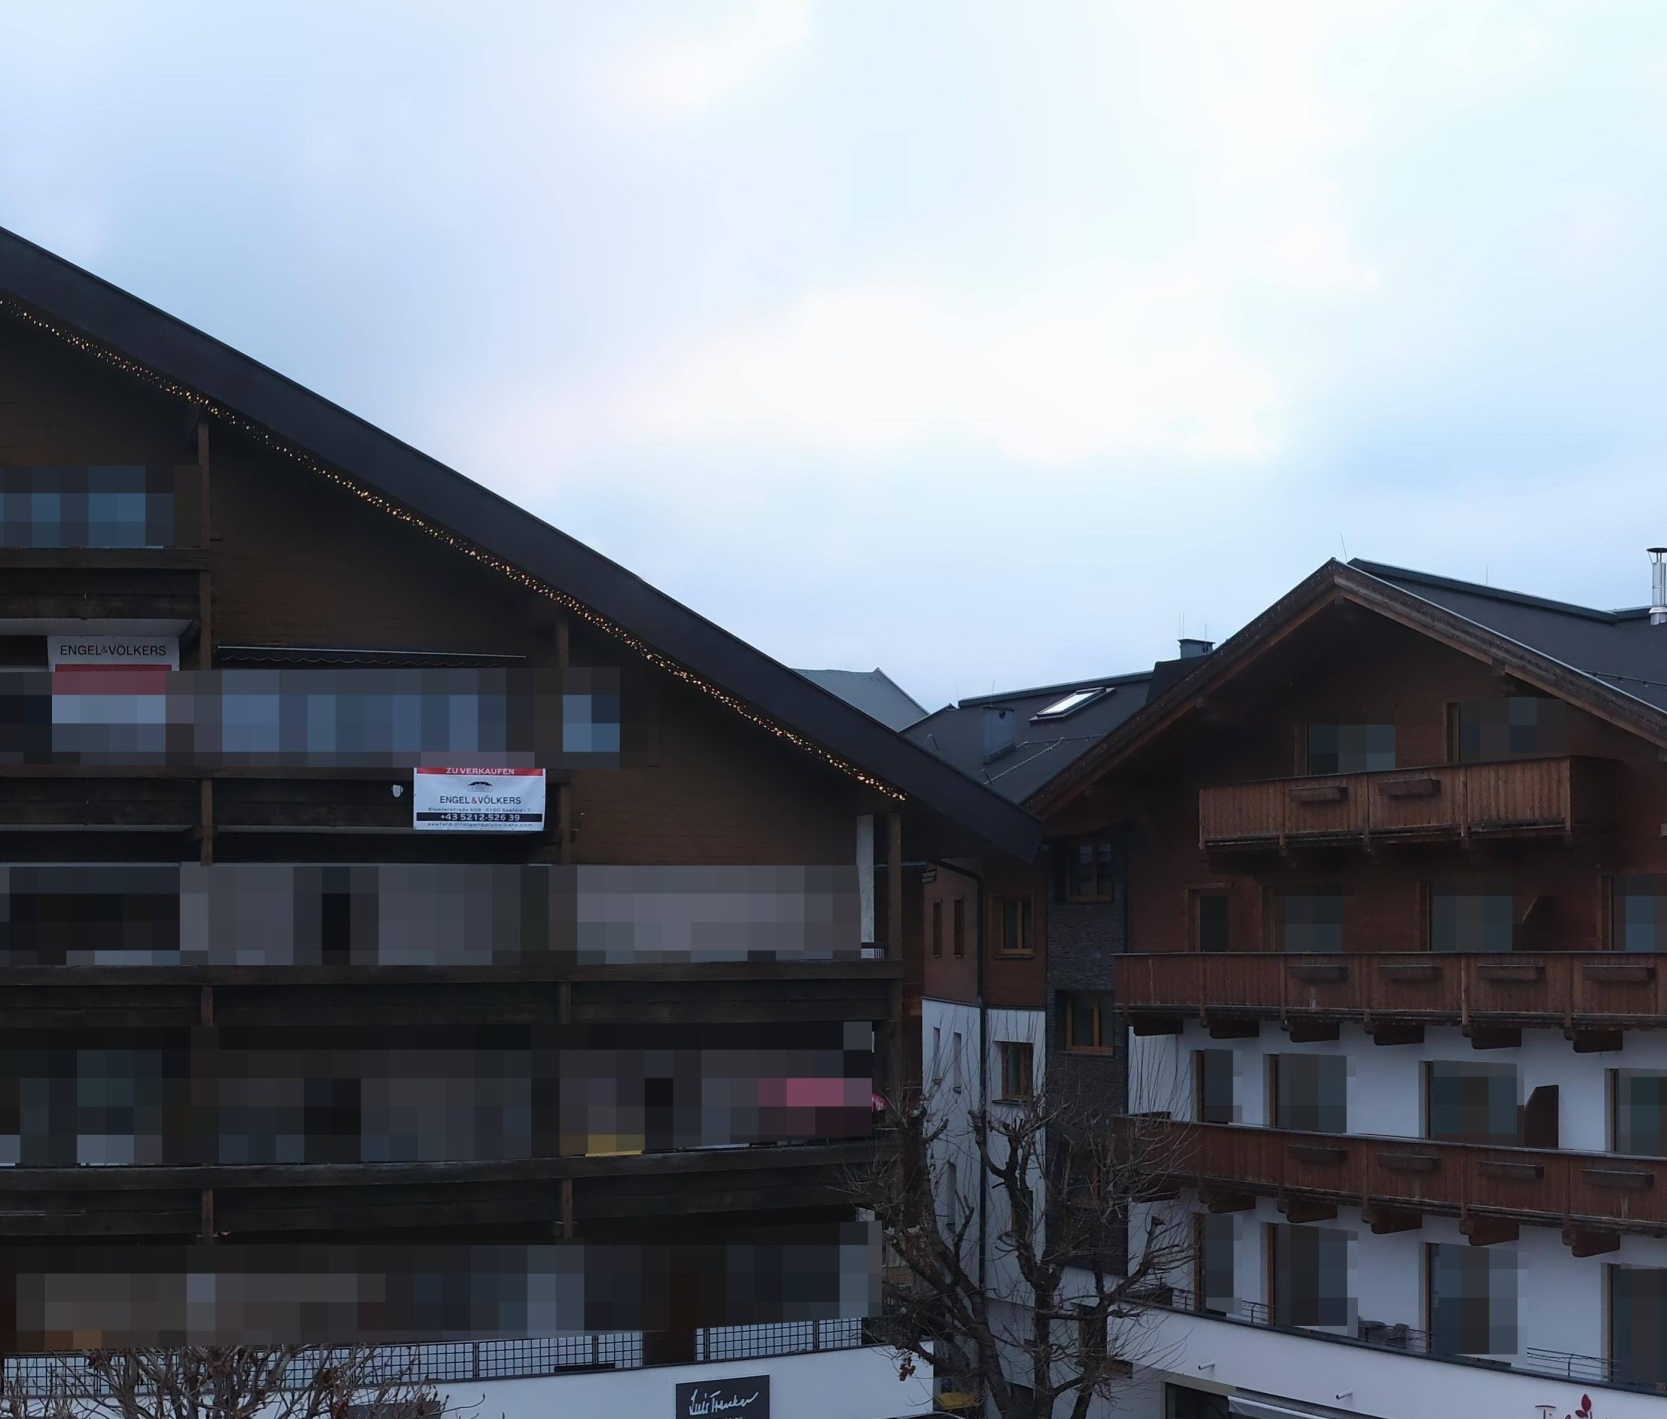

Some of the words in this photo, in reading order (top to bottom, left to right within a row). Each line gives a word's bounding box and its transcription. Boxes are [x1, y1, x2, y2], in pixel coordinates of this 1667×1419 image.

[60, 643, 166, 656] ENGEL&VÖLKERS
[439, 794, 522, 805] ENGEL&VÖLKERS
[460, 813, 506, 821] 5212-526
